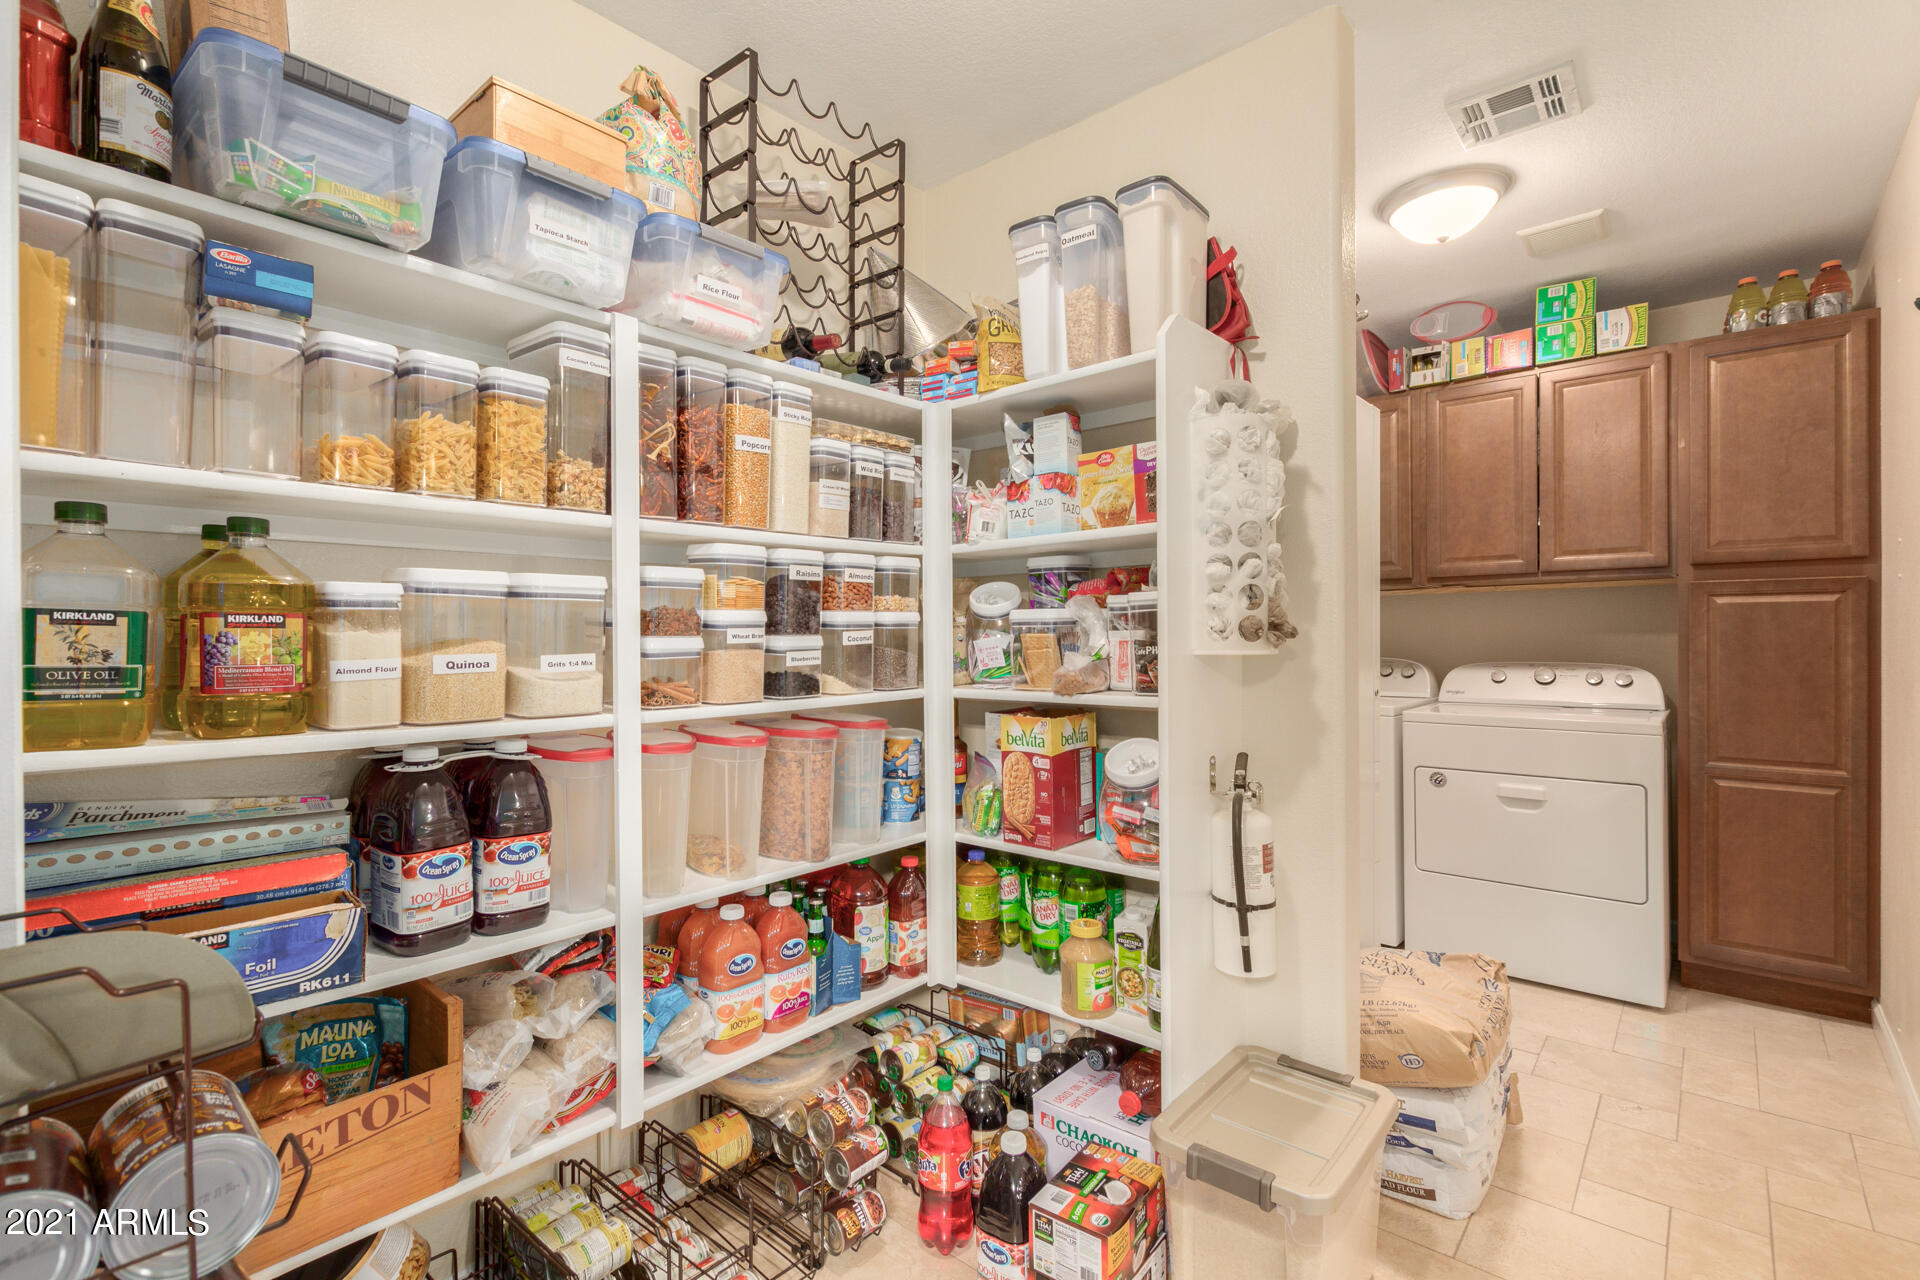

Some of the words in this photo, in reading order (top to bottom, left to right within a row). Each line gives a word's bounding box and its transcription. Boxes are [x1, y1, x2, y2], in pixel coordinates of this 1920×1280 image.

[534, 224, 564, 241] Tapioca
[566, 231, 588, 248] Starch
[1061, 229, 1095, 246] Oatmeal
[218, 250, 249, 264] Barilla
[215, 262, 247, 274] LASAGNE
[702, 283, 719, 296] Rice
[721, 287, 740, 301] Flour
[783, 412, 800, 421] Sticky
[861, 465, 873, 473] Wild
[1035, 498, 1053, 507] TAZO
[1062, 502, 1080, 515] TAZO
[795, 569, 821, 579] Raisins
[848, 572, 874, 582] Almonds
[53, 611, 115, 621] KIRKLAND
[227, 614, 284, 623] KIRKLAND
[731, 632, 750, 641] Wheat
[847, 635, 873, 643] Coconut
[217, 666, 264, 674] Mediterranean
[264, 665, 282, 673] Blend
[335, 666, 373, 677] Almond
[375, 665, 398, 675] Flour
[445, 660, 491, 670] Quinoa
[547, 661, 566, 669] Grits
[568, 660, 580, 668] 1:4
[46, 671, 91, 681] OLIVE
[94, 670, 119, 681] OIL
[1006, 727, 1046, 749] belVita
[1060, 724, 1089, 747] belVita
[67, 809, 188, 825] Parchment
[501, 850, 519, 861] Ocean
[519, 847, 536, 861] Spray
[421, 865, 442, 876] Ocean
[442, 859, 460, 875] Spray
[245, 957, 277, 976] Foil
[300, 972, 350, 993] RK611
[777, 971, 796, 983] Ruby
[300, 1019, 377, 1051] MAUNA
[320, 1043, 357, 1064] LOA
[836, 1096, 854, 1118] CHILI
[1064, 1167, 1086, 1184] THAI
[1397, 1184, 1427, 1197] FLOUR
[851, 1201, 868, 1228] CHILI
